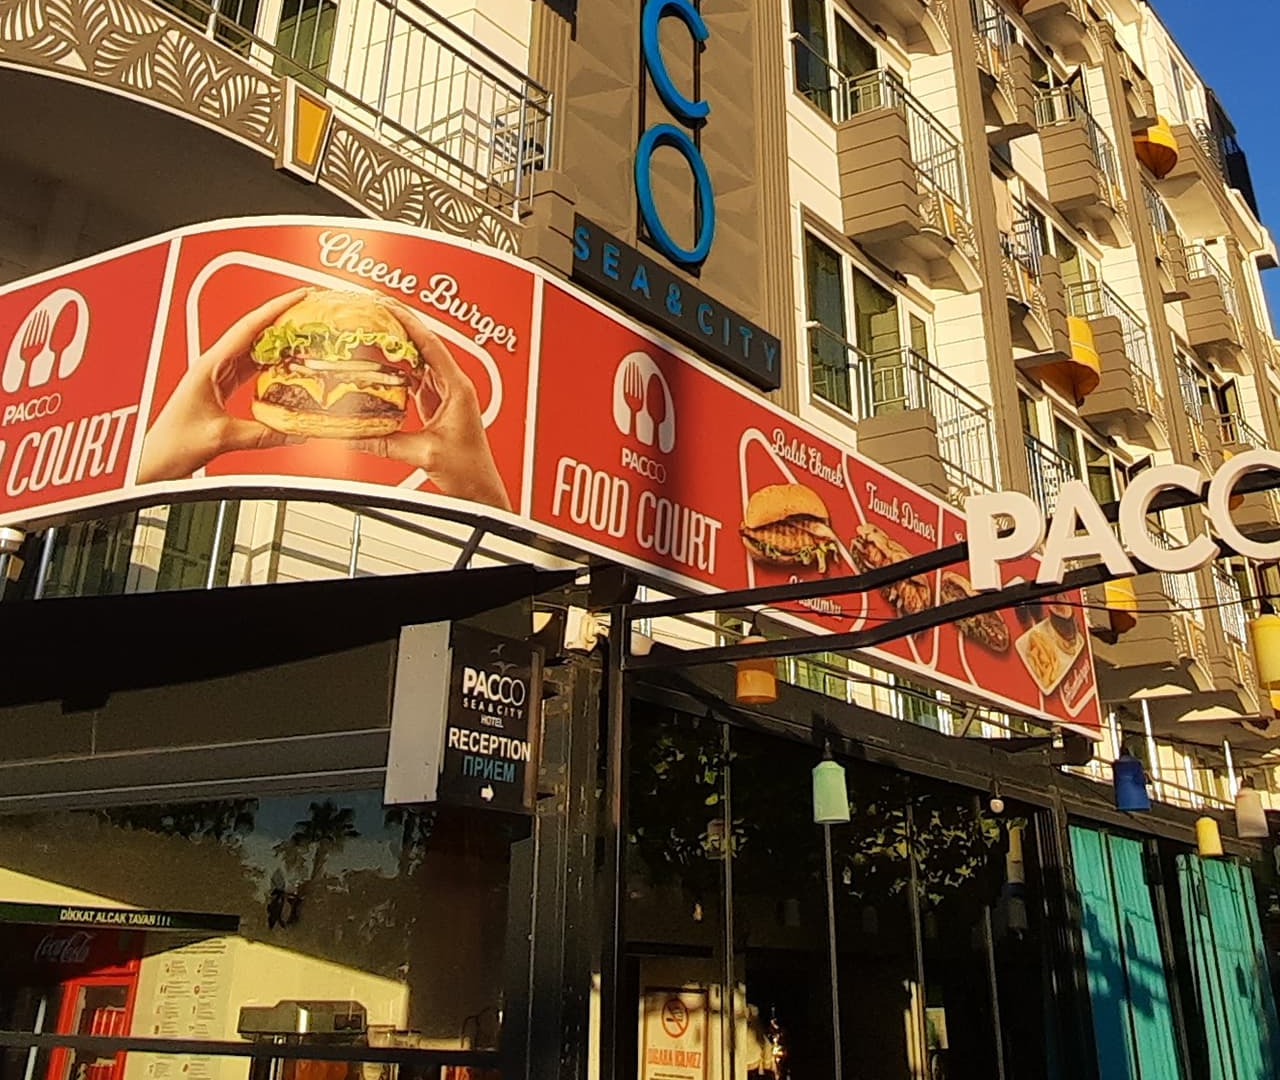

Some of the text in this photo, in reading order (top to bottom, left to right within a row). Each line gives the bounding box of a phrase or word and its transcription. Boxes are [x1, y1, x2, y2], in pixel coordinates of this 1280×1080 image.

[318, 230, 517, 353] Cheese Burger
[2, 393, 62, 427] PACCO
[6, 404, 139, 497] COURT
[621, 448, 666, 484] PACCO
[771, 428, 844, 488] Balık Ekmek
[551, 456, 723, 575] FOOD COURT
[865, 482, 936, 543] Tavuk Döner
[462, 667, 525, 707] PACCO
[480, 715, 504, 728] HOTEL
[448, 726, 531, 762] RECEPTION
[463, 755, 516, 783] ПРИЕМ
[60, 907, 96, 922] DİKKAT
